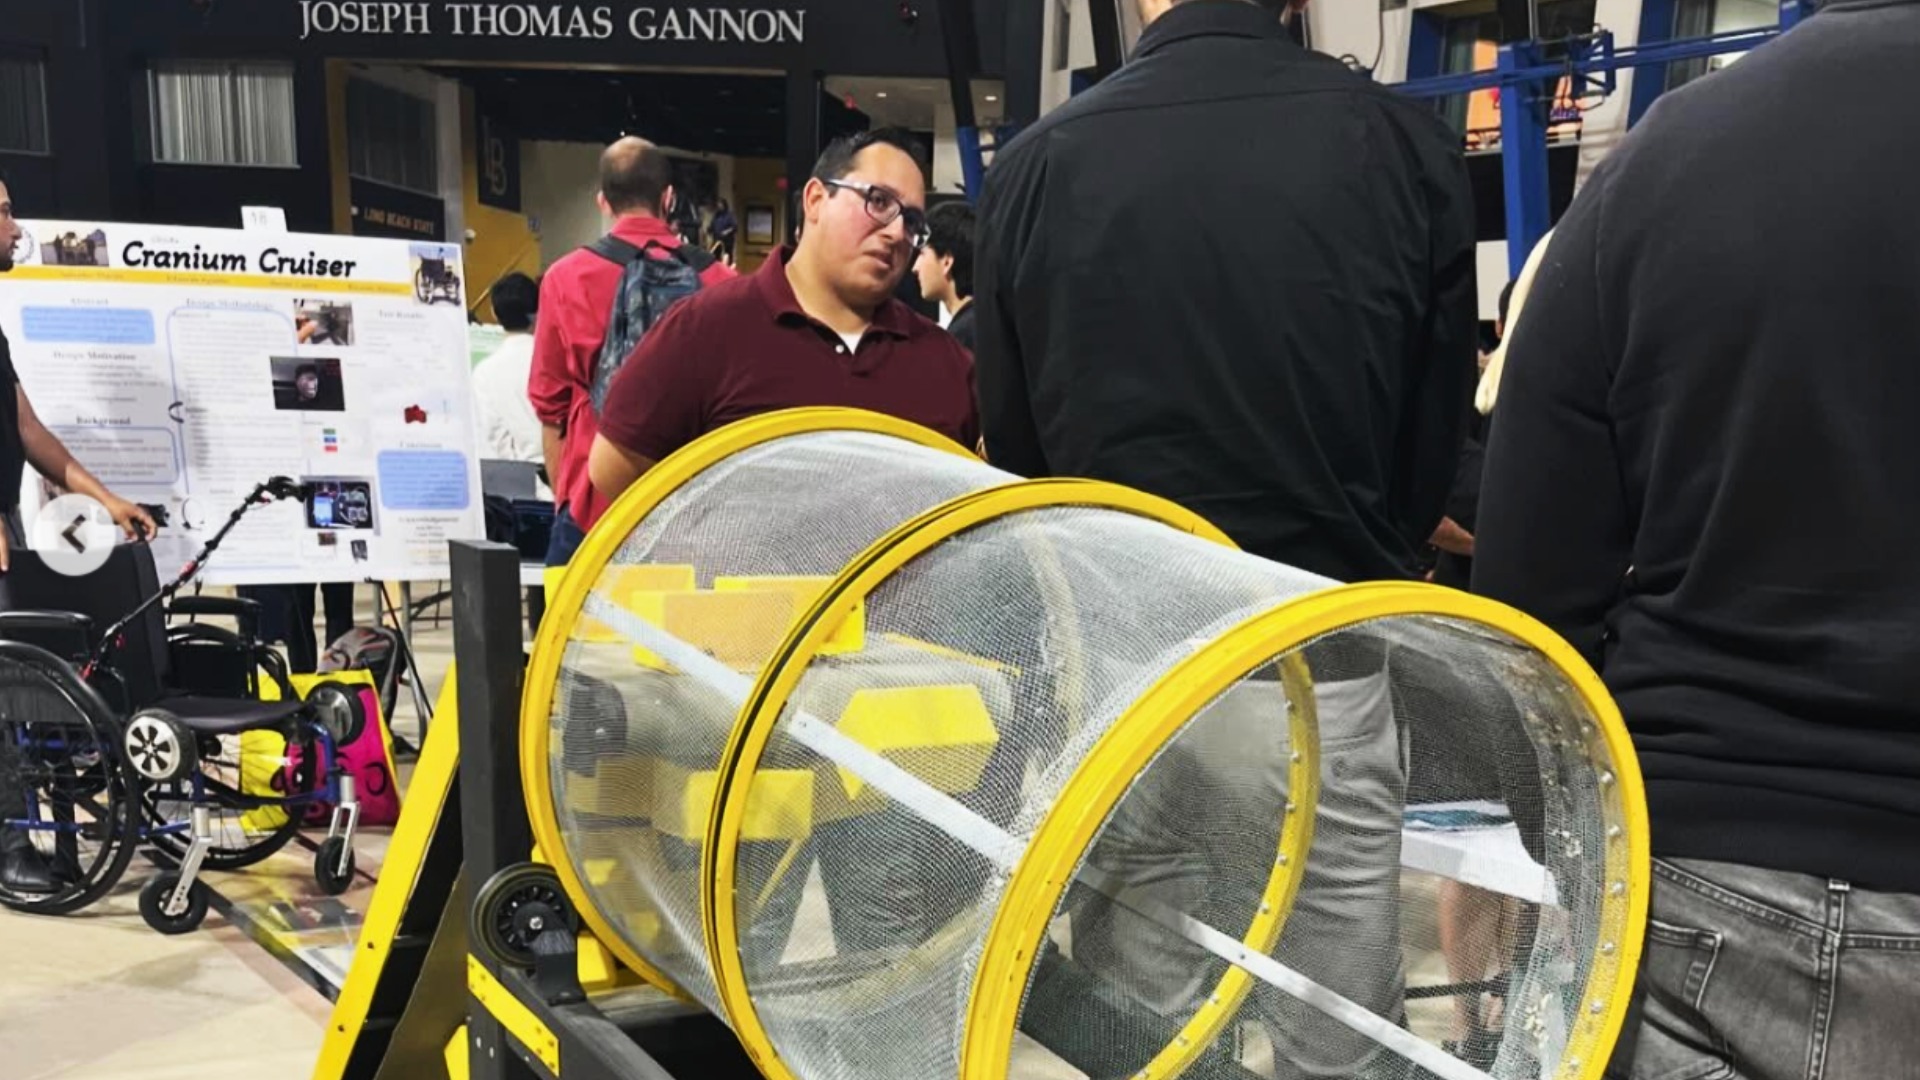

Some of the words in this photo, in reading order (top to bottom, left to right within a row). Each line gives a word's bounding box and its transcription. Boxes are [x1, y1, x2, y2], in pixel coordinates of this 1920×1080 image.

[300, 2, 431, 39] JOSEPH
[446, 3, 613, 38] THOMAS
[628, 7, 806, 42] GANNON
[364, 207, 384, 224] LONG
[387, 212, 411, 229] BEACH
[413, 218, 434, 236] STATE
[122, 241, 247, 272] Cranium
[259, 248, 357, 277] Cruiser
[76, 416, 131, 426] Background
